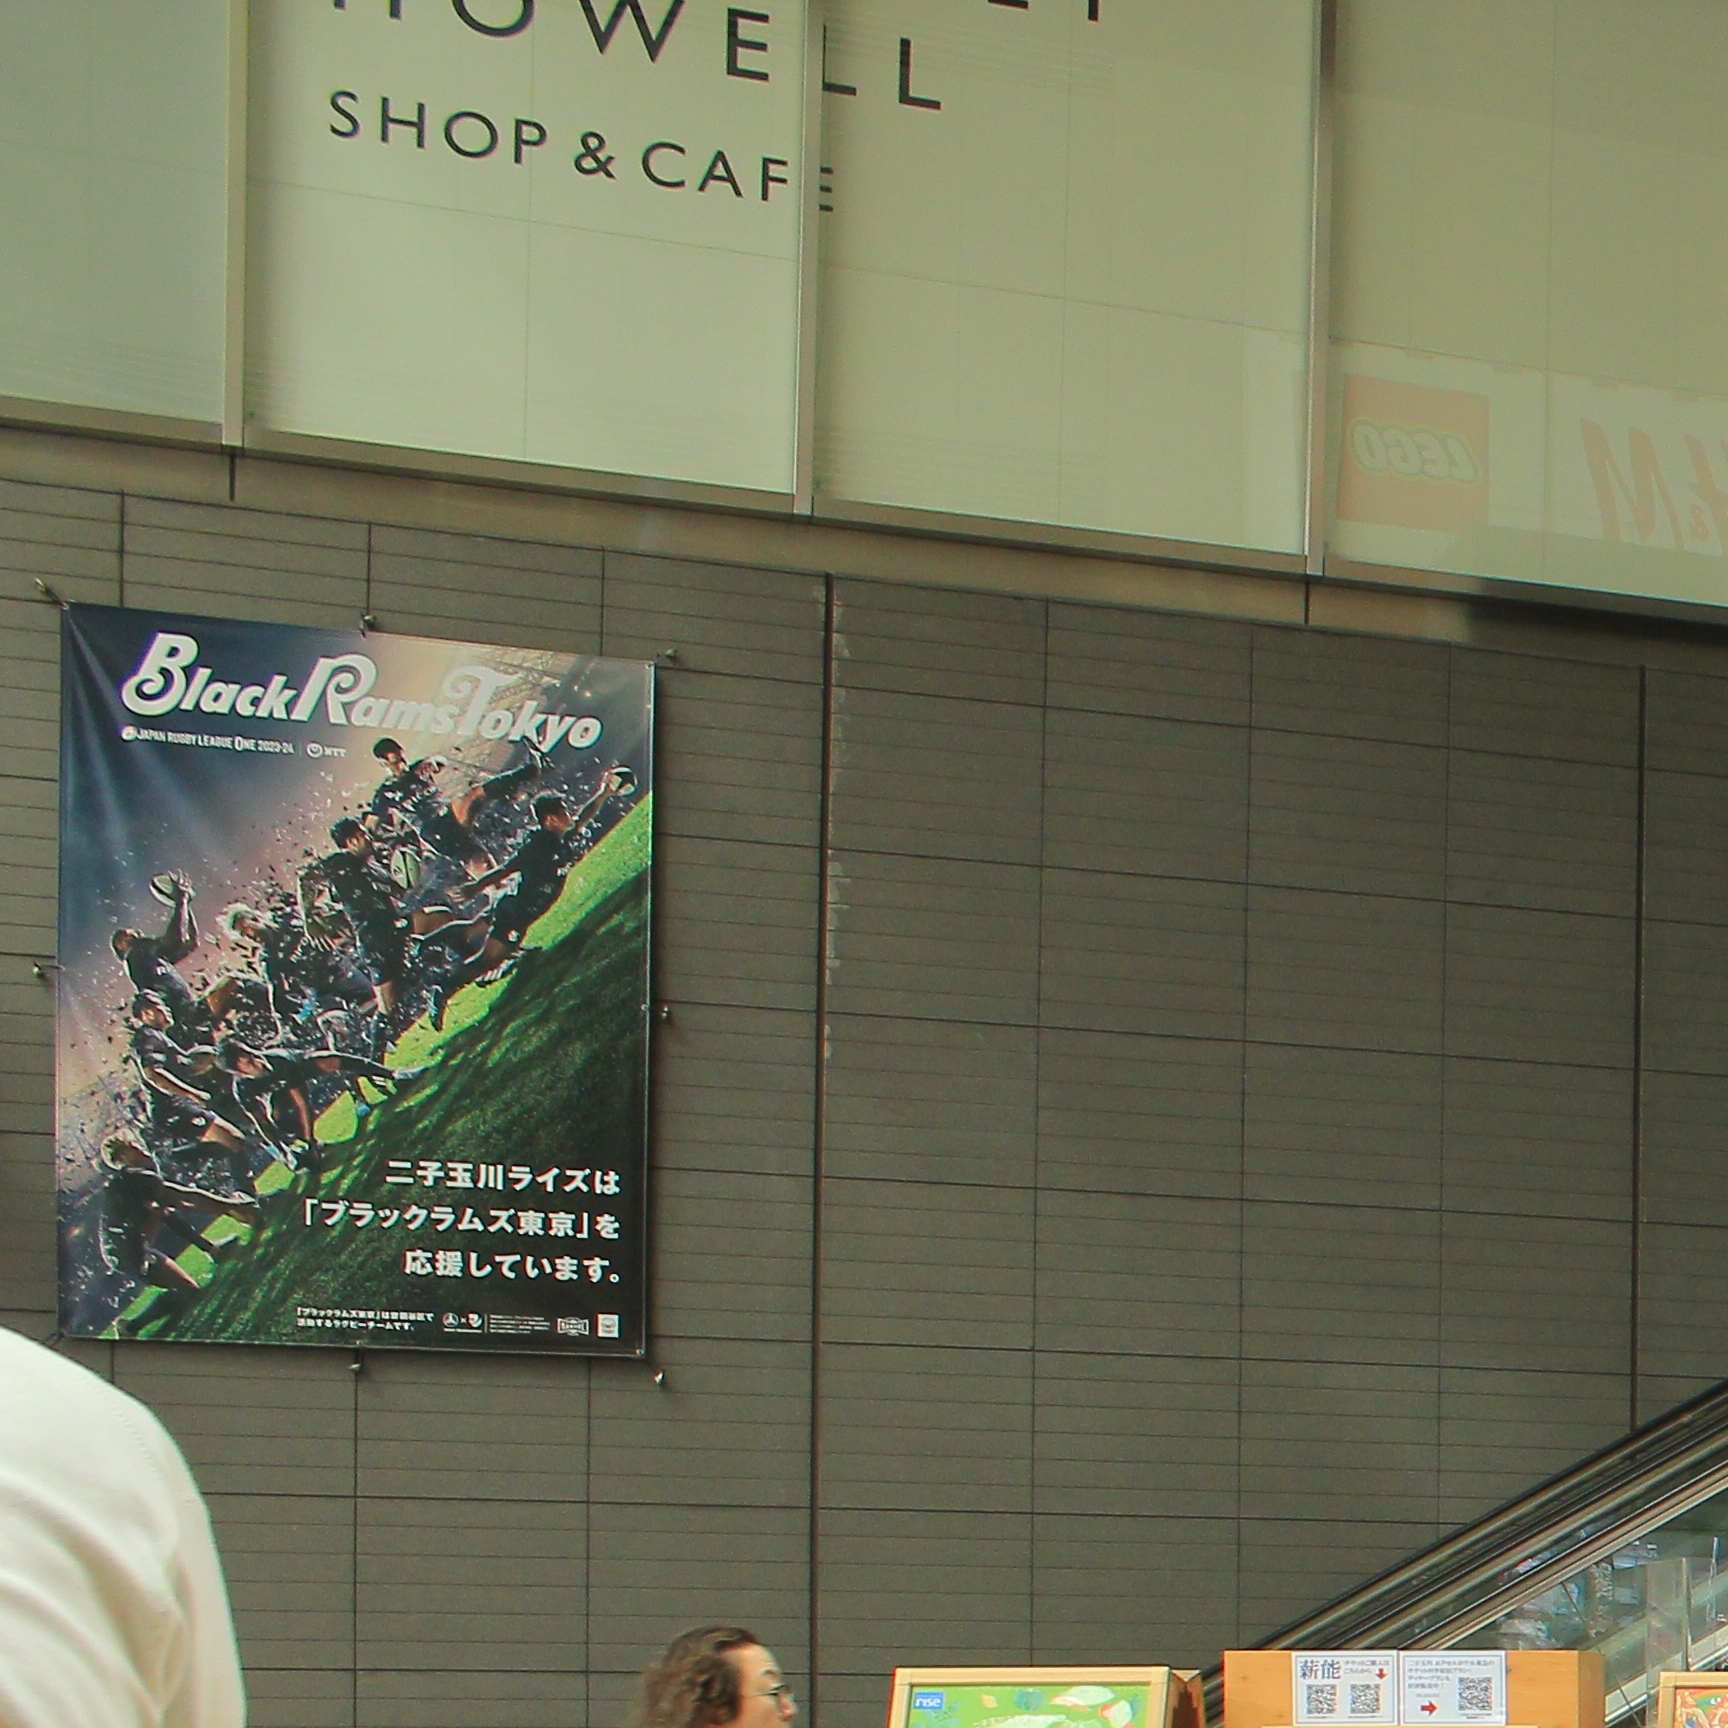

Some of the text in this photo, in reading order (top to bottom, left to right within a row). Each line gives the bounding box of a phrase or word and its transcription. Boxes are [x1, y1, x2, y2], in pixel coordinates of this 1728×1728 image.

[329, 90, 547, 165] SHOP
[573, 131, 615, 180] &
[121, 631, 603, 754] Black Rams Tokyo
[137, 728, 166, 743] JAPAN
[167, 730, 197, 746] RUGBY
[197, 734, 233, 749] LEAGUE
[385, 1159, 621, 1197] 二子玉川ライズは
[302, 1199, 621, 1241] 「ブラックラムズ東京」を
[404, 1248, 622, 1286] 応援しています。
